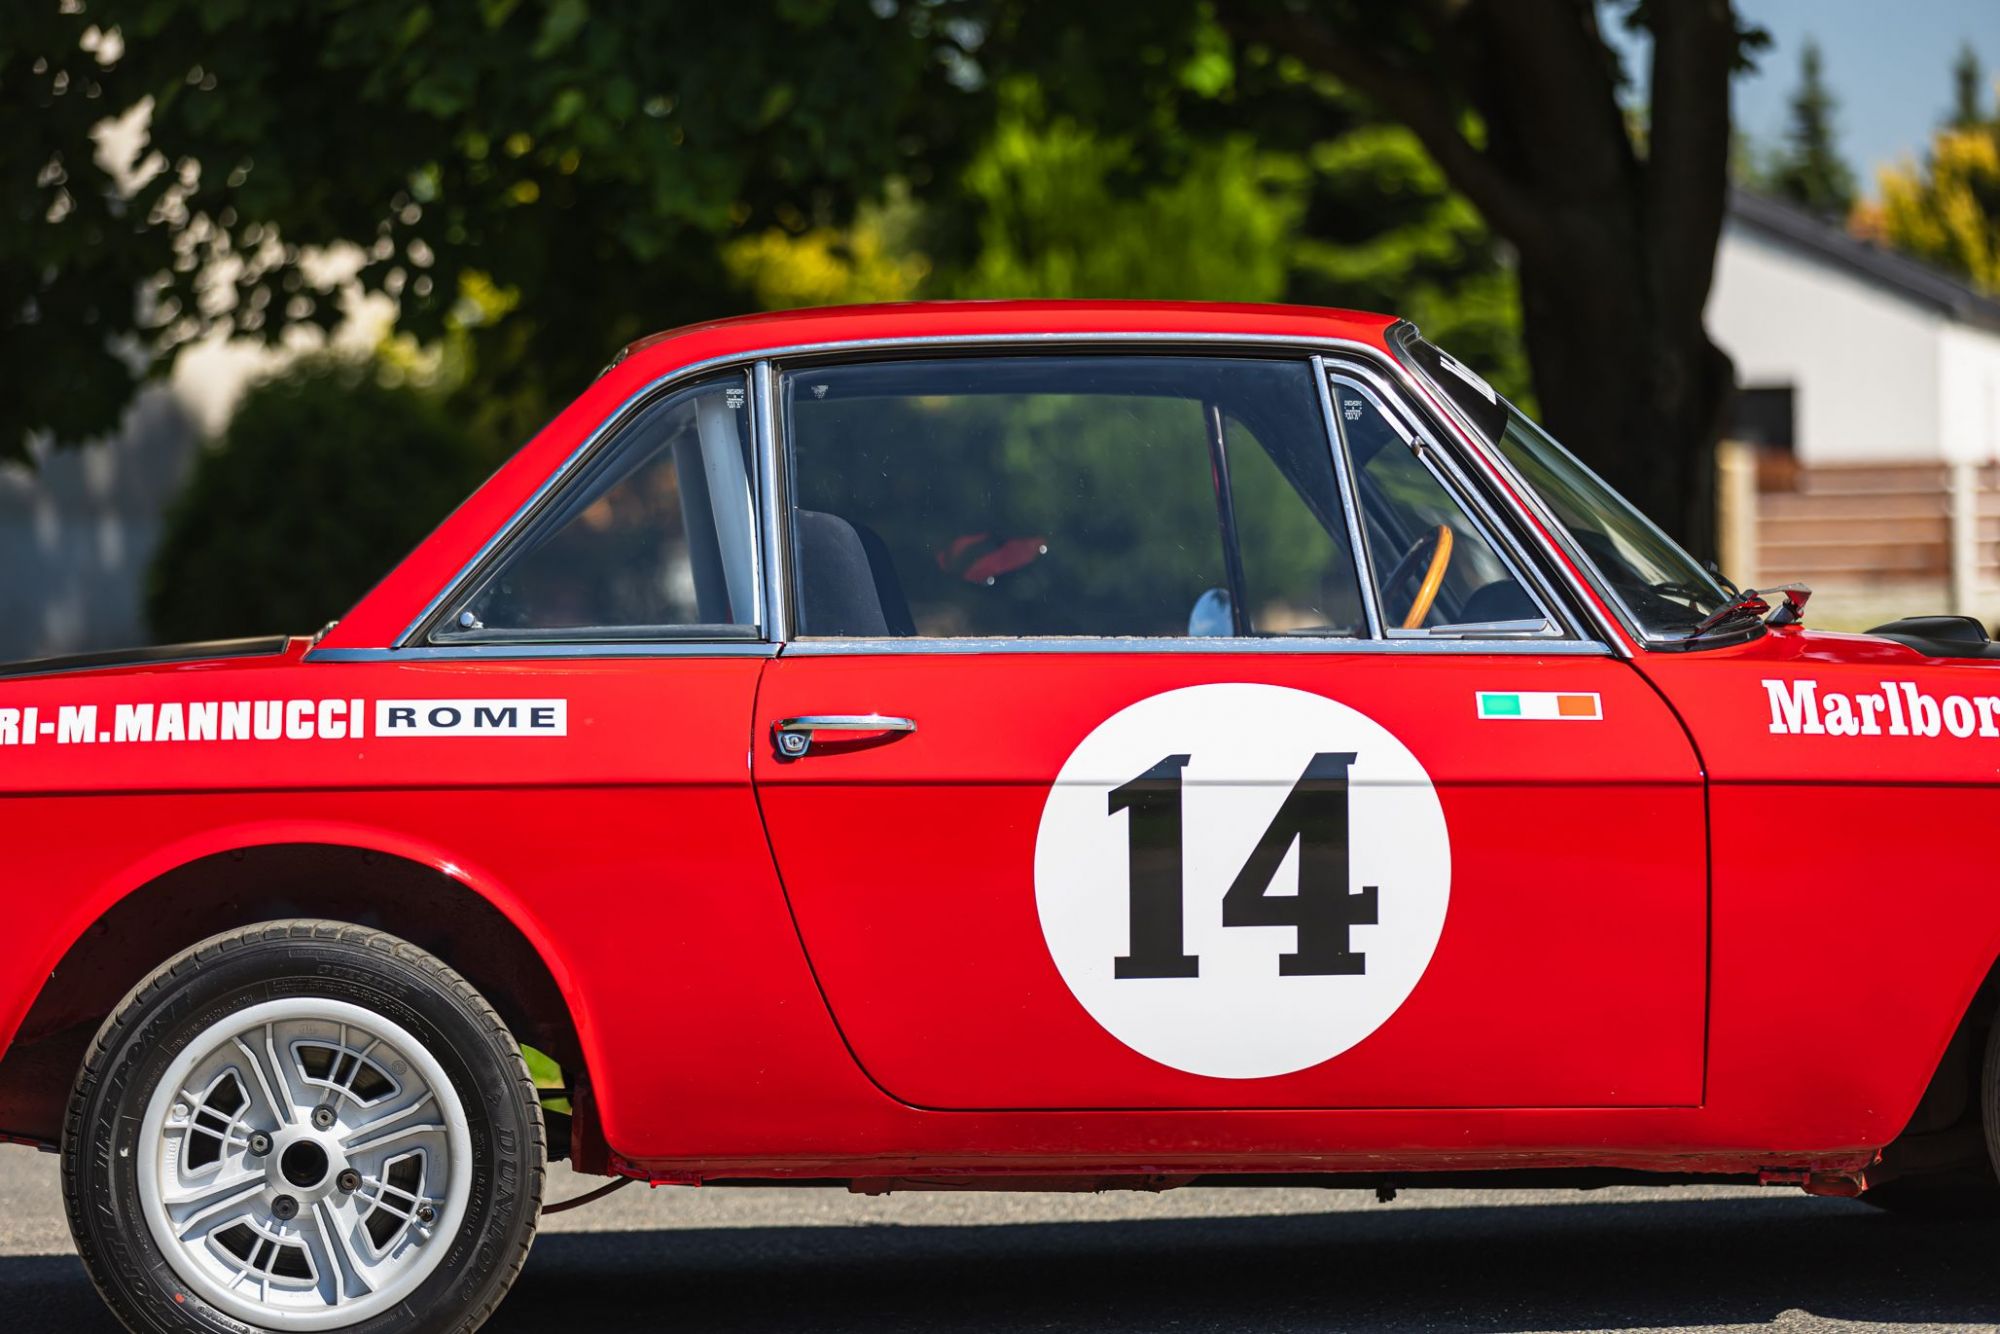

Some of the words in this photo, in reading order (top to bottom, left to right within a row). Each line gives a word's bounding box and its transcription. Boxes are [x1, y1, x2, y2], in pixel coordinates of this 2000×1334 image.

[389, 708, 555, 728] ROME
[1762, 680, 2000, 738] Marlbor
[1108, 752, 1379, 980] 14
